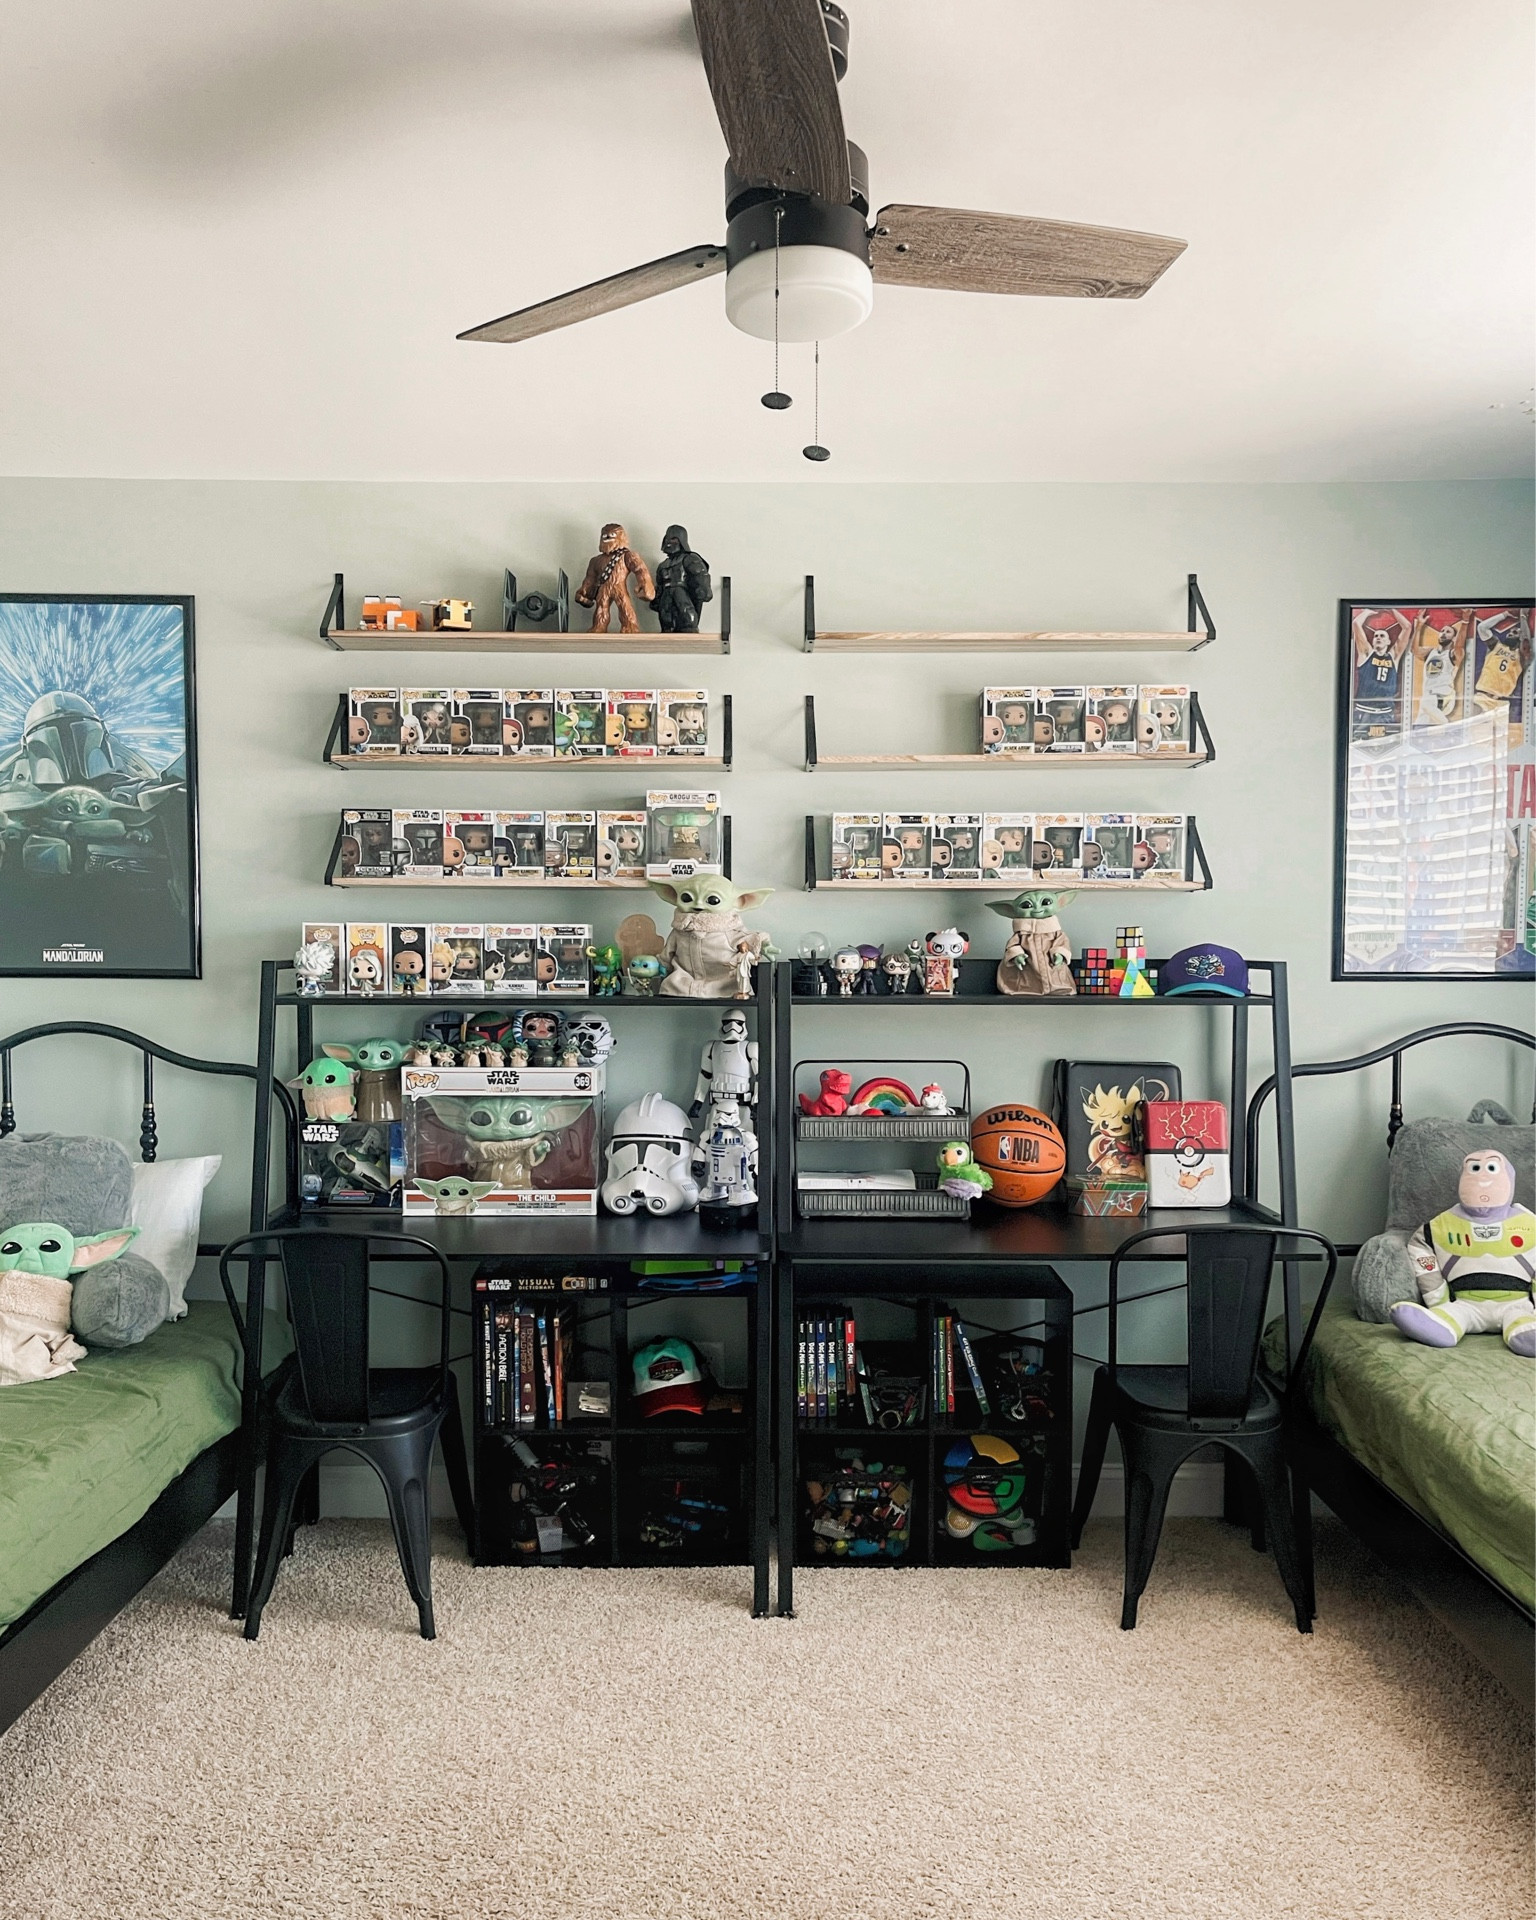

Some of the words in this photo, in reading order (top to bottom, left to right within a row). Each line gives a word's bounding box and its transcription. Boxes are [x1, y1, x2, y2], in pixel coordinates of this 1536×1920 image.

[1499, 659, 1508, 672] 6
[1376, 667, 1389, 682] 15
[43, 951, 103, 962] MANDALORIAN
[407, 1073, 440, 1089] POP!
[575, 1076, 589, 1087] 369
[303, 1124, 339, 1134] STAR
[986, 1110, 1055, 1135] Wilson
[303, 1133, 339, 1143] WARS
[1013, 1137, 1039, 1163] NBA
[498, 1337, 507, 1364] ACTION
[498, 1364, 507, 1382] BIBLE
